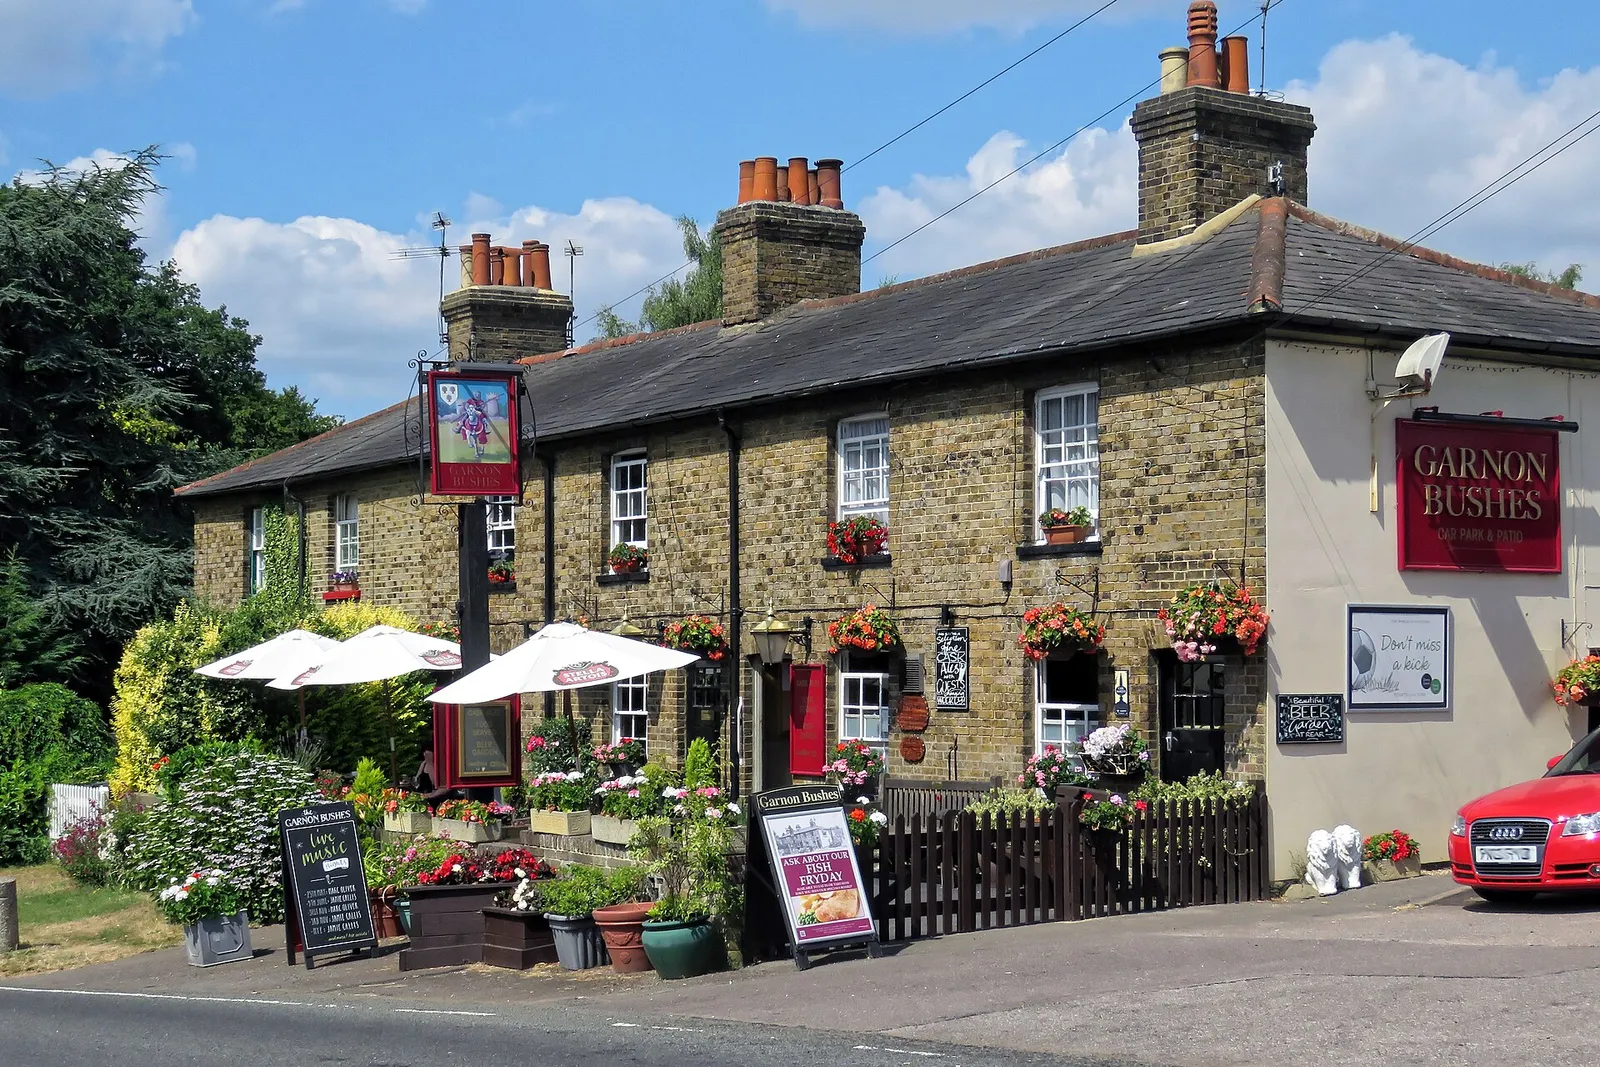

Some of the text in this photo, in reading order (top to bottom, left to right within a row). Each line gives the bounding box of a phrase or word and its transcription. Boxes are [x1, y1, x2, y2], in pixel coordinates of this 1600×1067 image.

[449, 465, 501, 476] GARNON
[1414, 444, 1547, 482] GARNON
[453, 476, 500, 487] BUSHES
[1423, 483, 1542, 520] BUSHES
[1438, 527, 1523, 543] CAR PARK & PATIO
[1381, 634, 1442, 652] Don't miss
[1392, 655, 1431, 671] a kick
[563, 667, 606, 680] STELLA
[566, 672, 609, 683] ARTOIS
[1292, 696, 1325, 704] Beautiful
[1290, 704, 1331, 718] BEER
[1288, 718, 1335, 732] Garden
[760, 789, 839, 808] Garnon Bushes
[285, 810, 351, 828] GARNON BUSHES
[310, 829, 335, 848] live
[302, 841, 347, 867] music
[784, 851, 849, 867] ASK ABOUT OUR
[806, 861, 832, 875] FISH
[799, 871, 843, 886] FRYDAY
